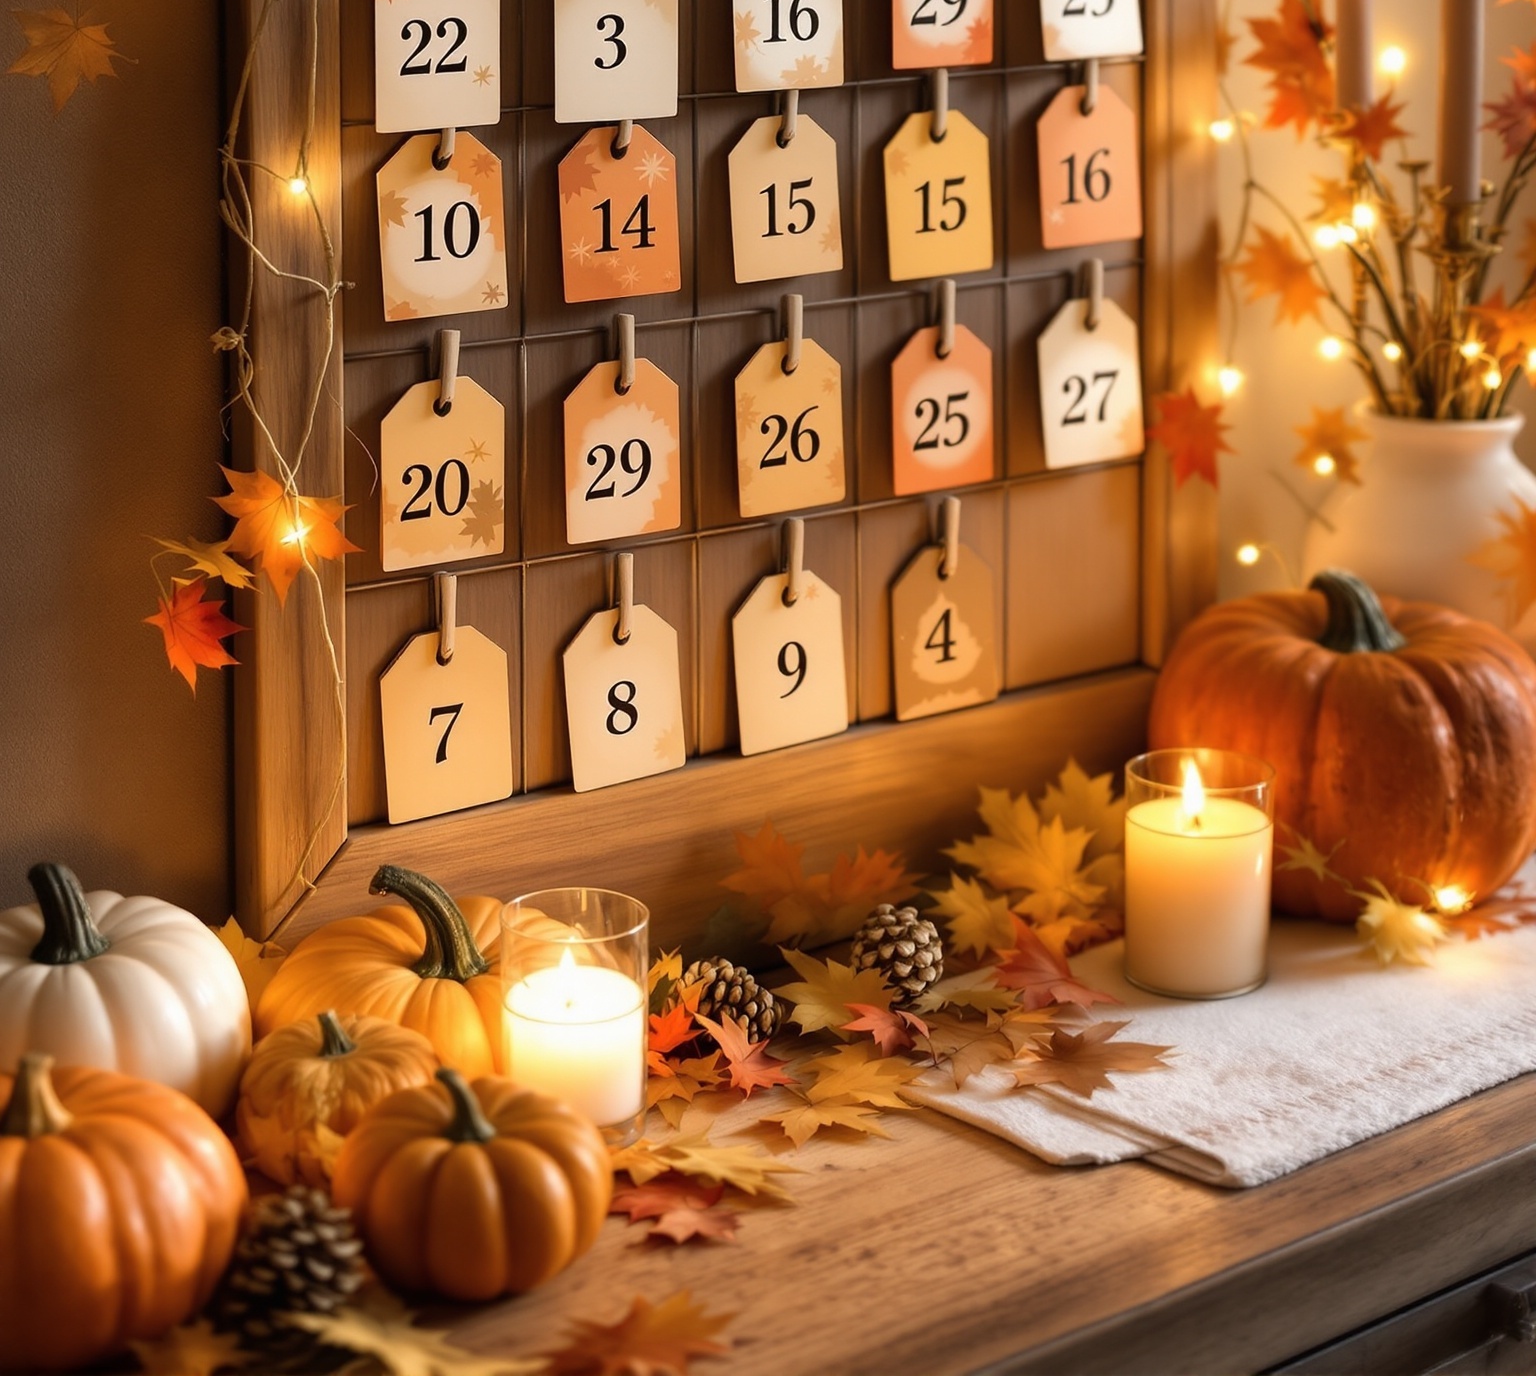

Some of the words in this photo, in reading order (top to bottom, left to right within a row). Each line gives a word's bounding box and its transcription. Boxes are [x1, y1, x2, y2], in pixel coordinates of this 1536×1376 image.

[399, 17, 468, 77] 22
[594, 14, 627, 70] 3
[759, 177, 816, 238] 15
[915, 177, 967, 234] 15
[1061, 149, 1111, 206] 16
[414, 201, 480, 263] 10
[592, 194, 656, 254] 14
[912, 391, 970, 451] 25
[1061, 369, 1118, 426] 27
[759, 405, 820, 470] 26
[400, 458, 470, 522] 20
[585, 438, 652, 502] 29
[924, 608, 955, 663] 4
[777, 641, 807, 699] 9
[429, 702, 464, 764] 7
[606, 680, 638, 735] 8
